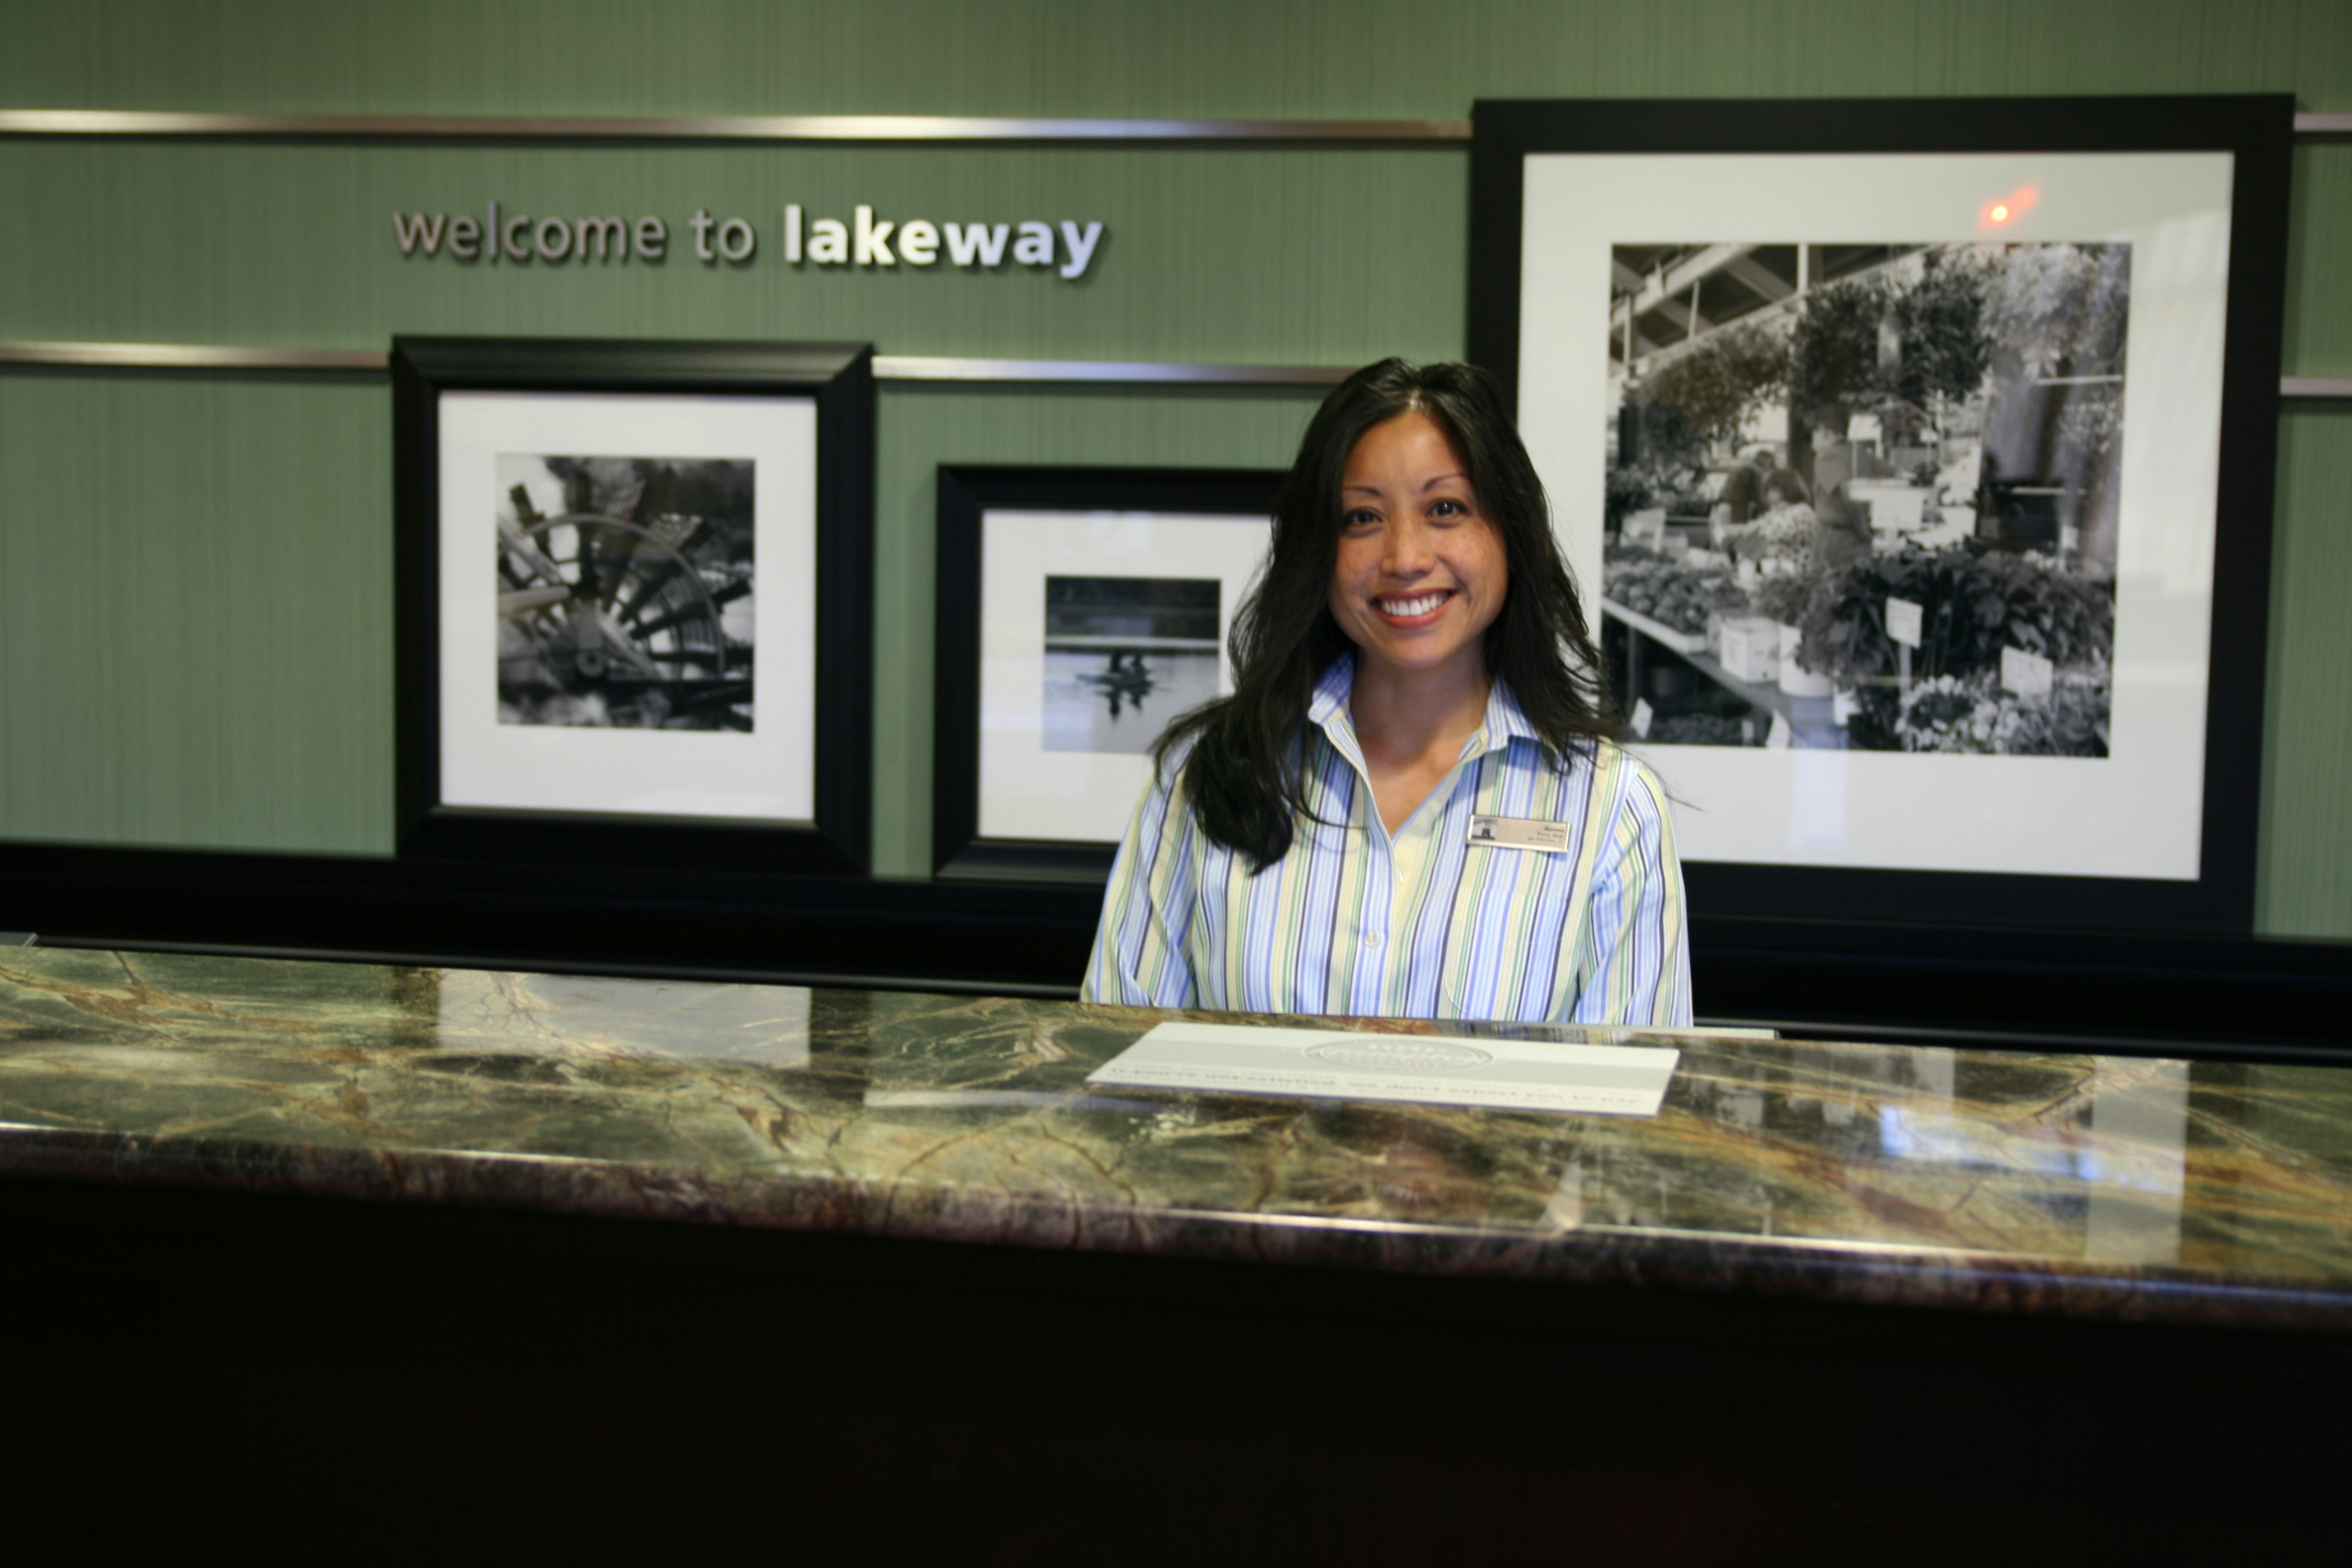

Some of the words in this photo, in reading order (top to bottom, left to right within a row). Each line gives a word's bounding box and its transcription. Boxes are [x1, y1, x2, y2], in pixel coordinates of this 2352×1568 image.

[393, 201, 666, 259] welcome
[688, 209, 755, 261] to
[784, 204, 1103, 279] lakeway
